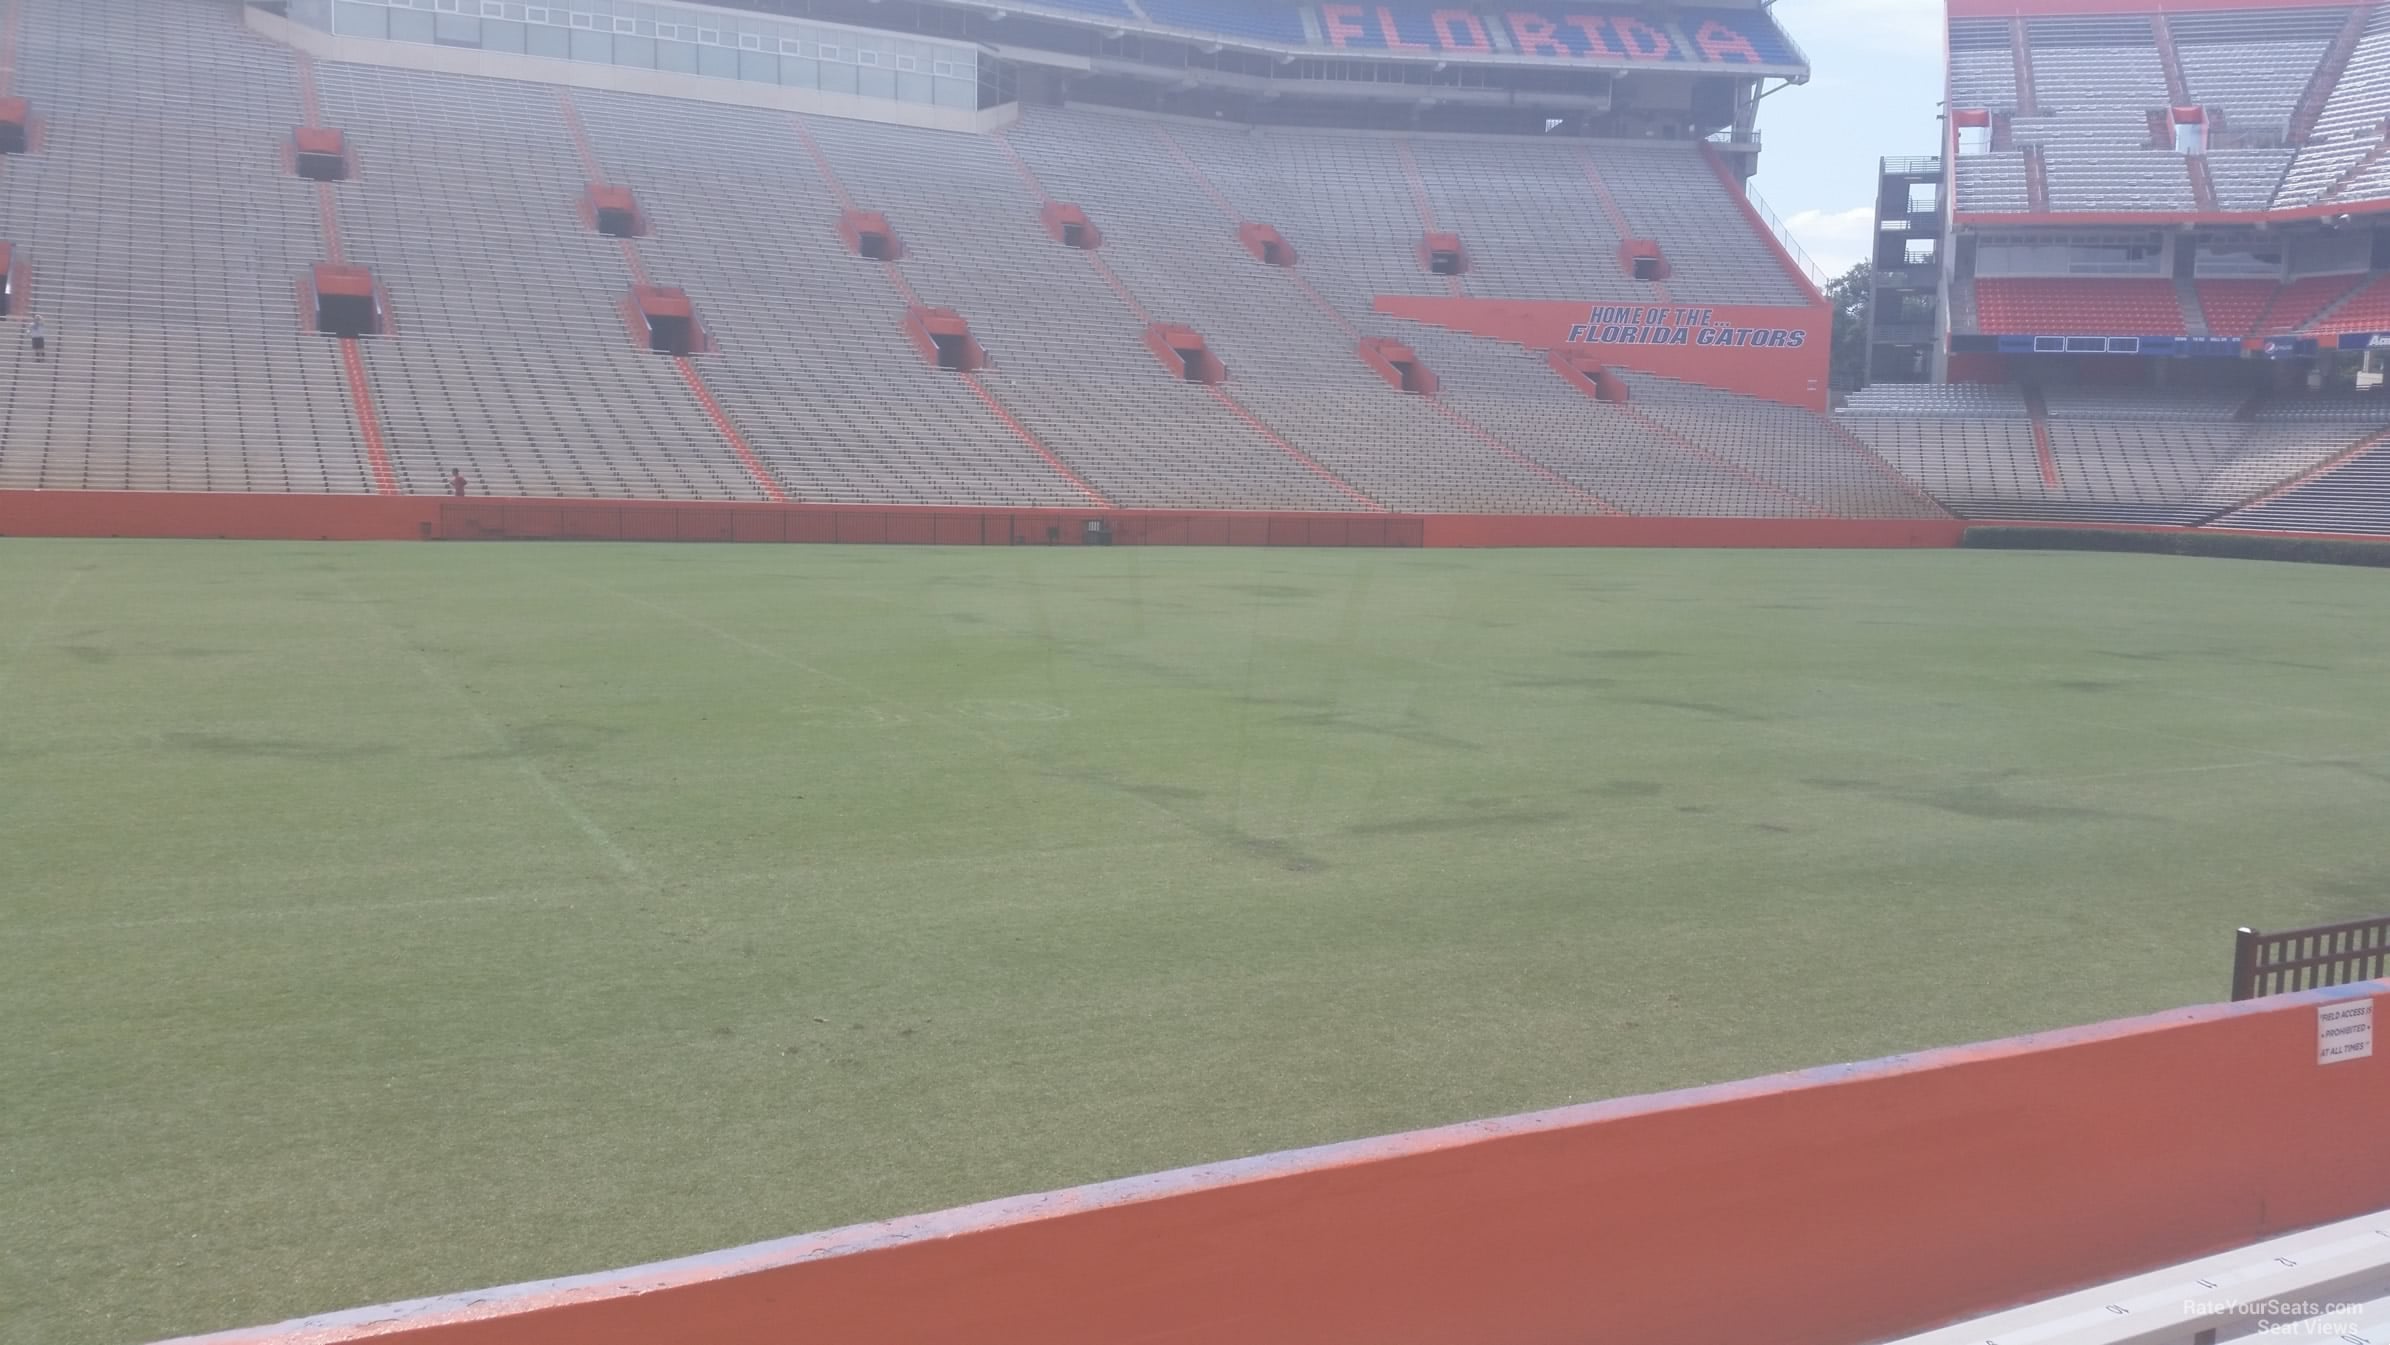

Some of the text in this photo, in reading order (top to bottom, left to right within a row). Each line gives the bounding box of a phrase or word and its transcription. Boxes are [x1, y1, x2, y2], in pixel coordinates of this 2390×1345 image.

[1320, 3, 1763, 65] FLORIDA
[1588, 306, 1643, 325] HOME
[1645, 307, 1670, 325] OF
[1565, 324, 1807, 348] FLORIDA GATORS
[2341, 1007, 2365, 1018] ACCESS
[2325, 1023, 2366, 1038] PROHIBITED
[2330, 1047, 2343, 1055] ALL
